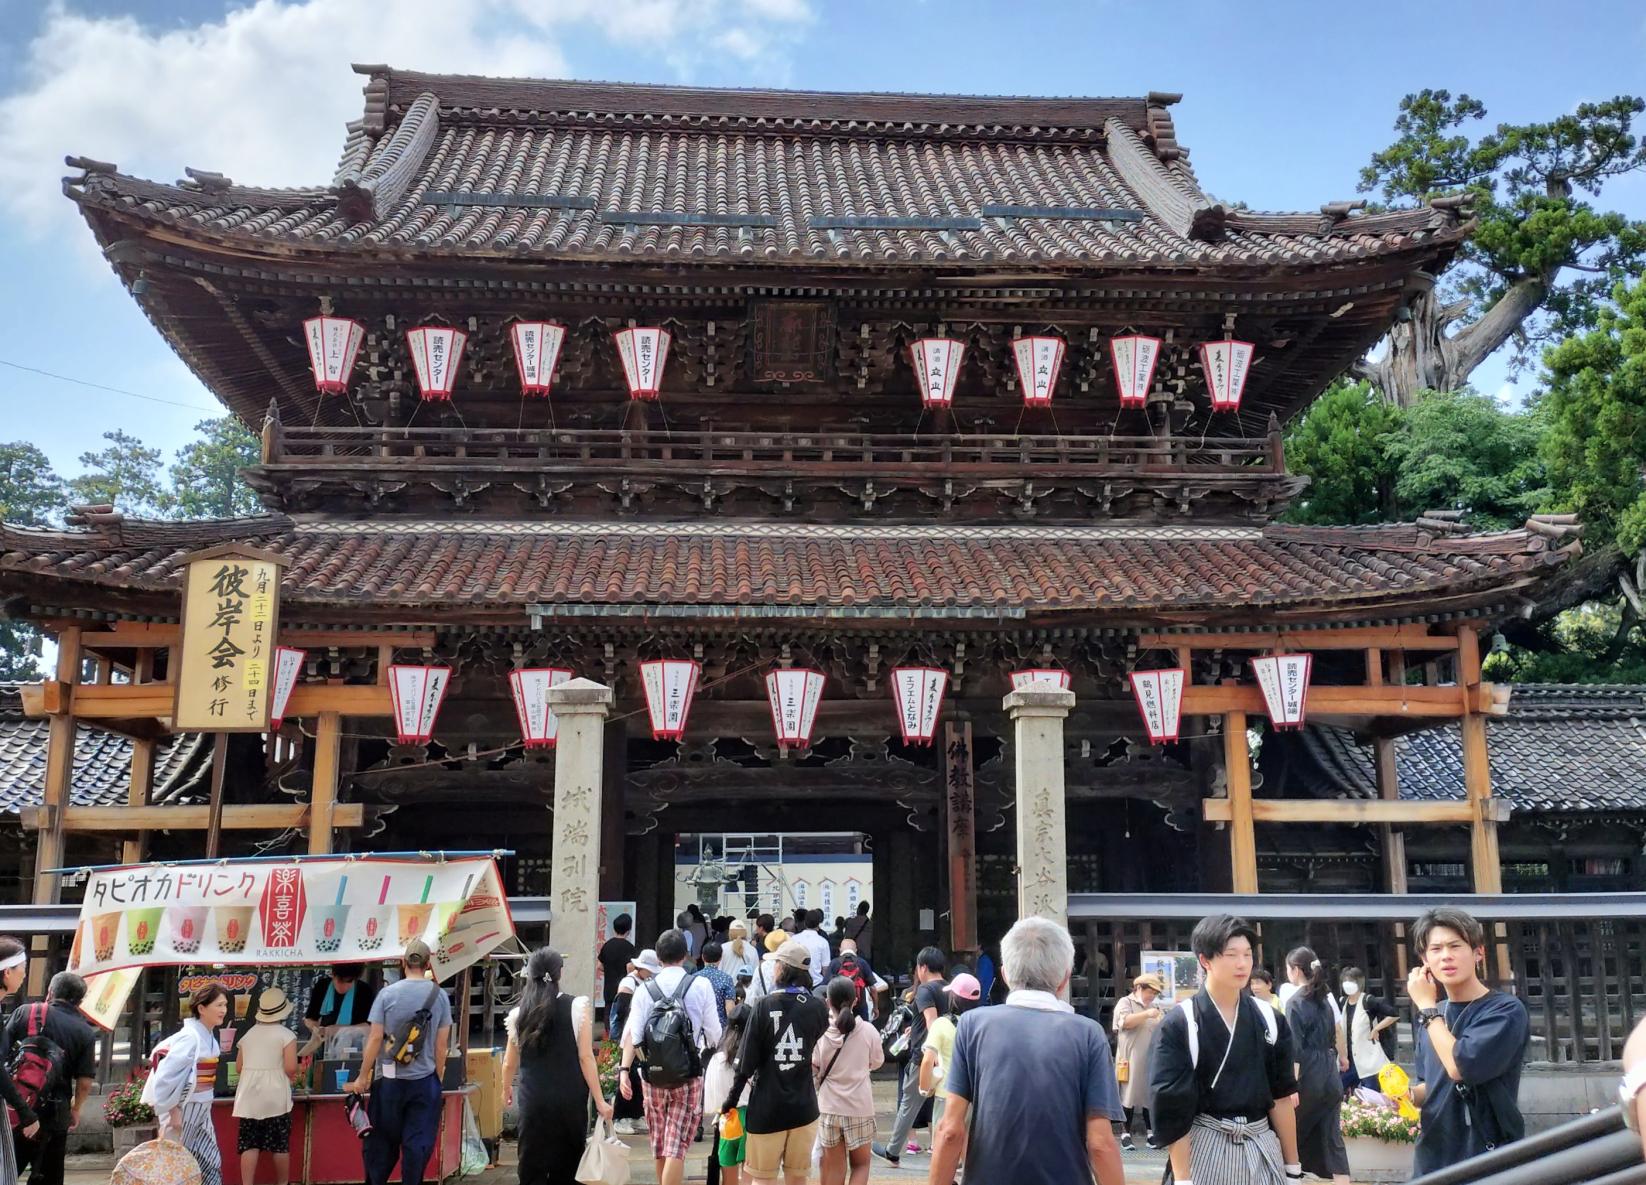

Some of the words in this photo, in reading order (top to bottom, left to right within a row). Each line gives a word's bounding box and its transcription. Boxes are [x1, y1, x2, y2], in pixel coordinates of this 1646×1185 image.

[433, 335, 444, 384] 読売センター
[641, 336, 652, 384] 読売センター
[206, 564, 251, 717] 彼岸会修行
[906, 675, 918, 729] エフエムとなみ
[93, 871, 255, 907] タピオカドリンク
[256, 949, 304, 957] RAKKICHA
[769, 1010, 804, 1061] LA
